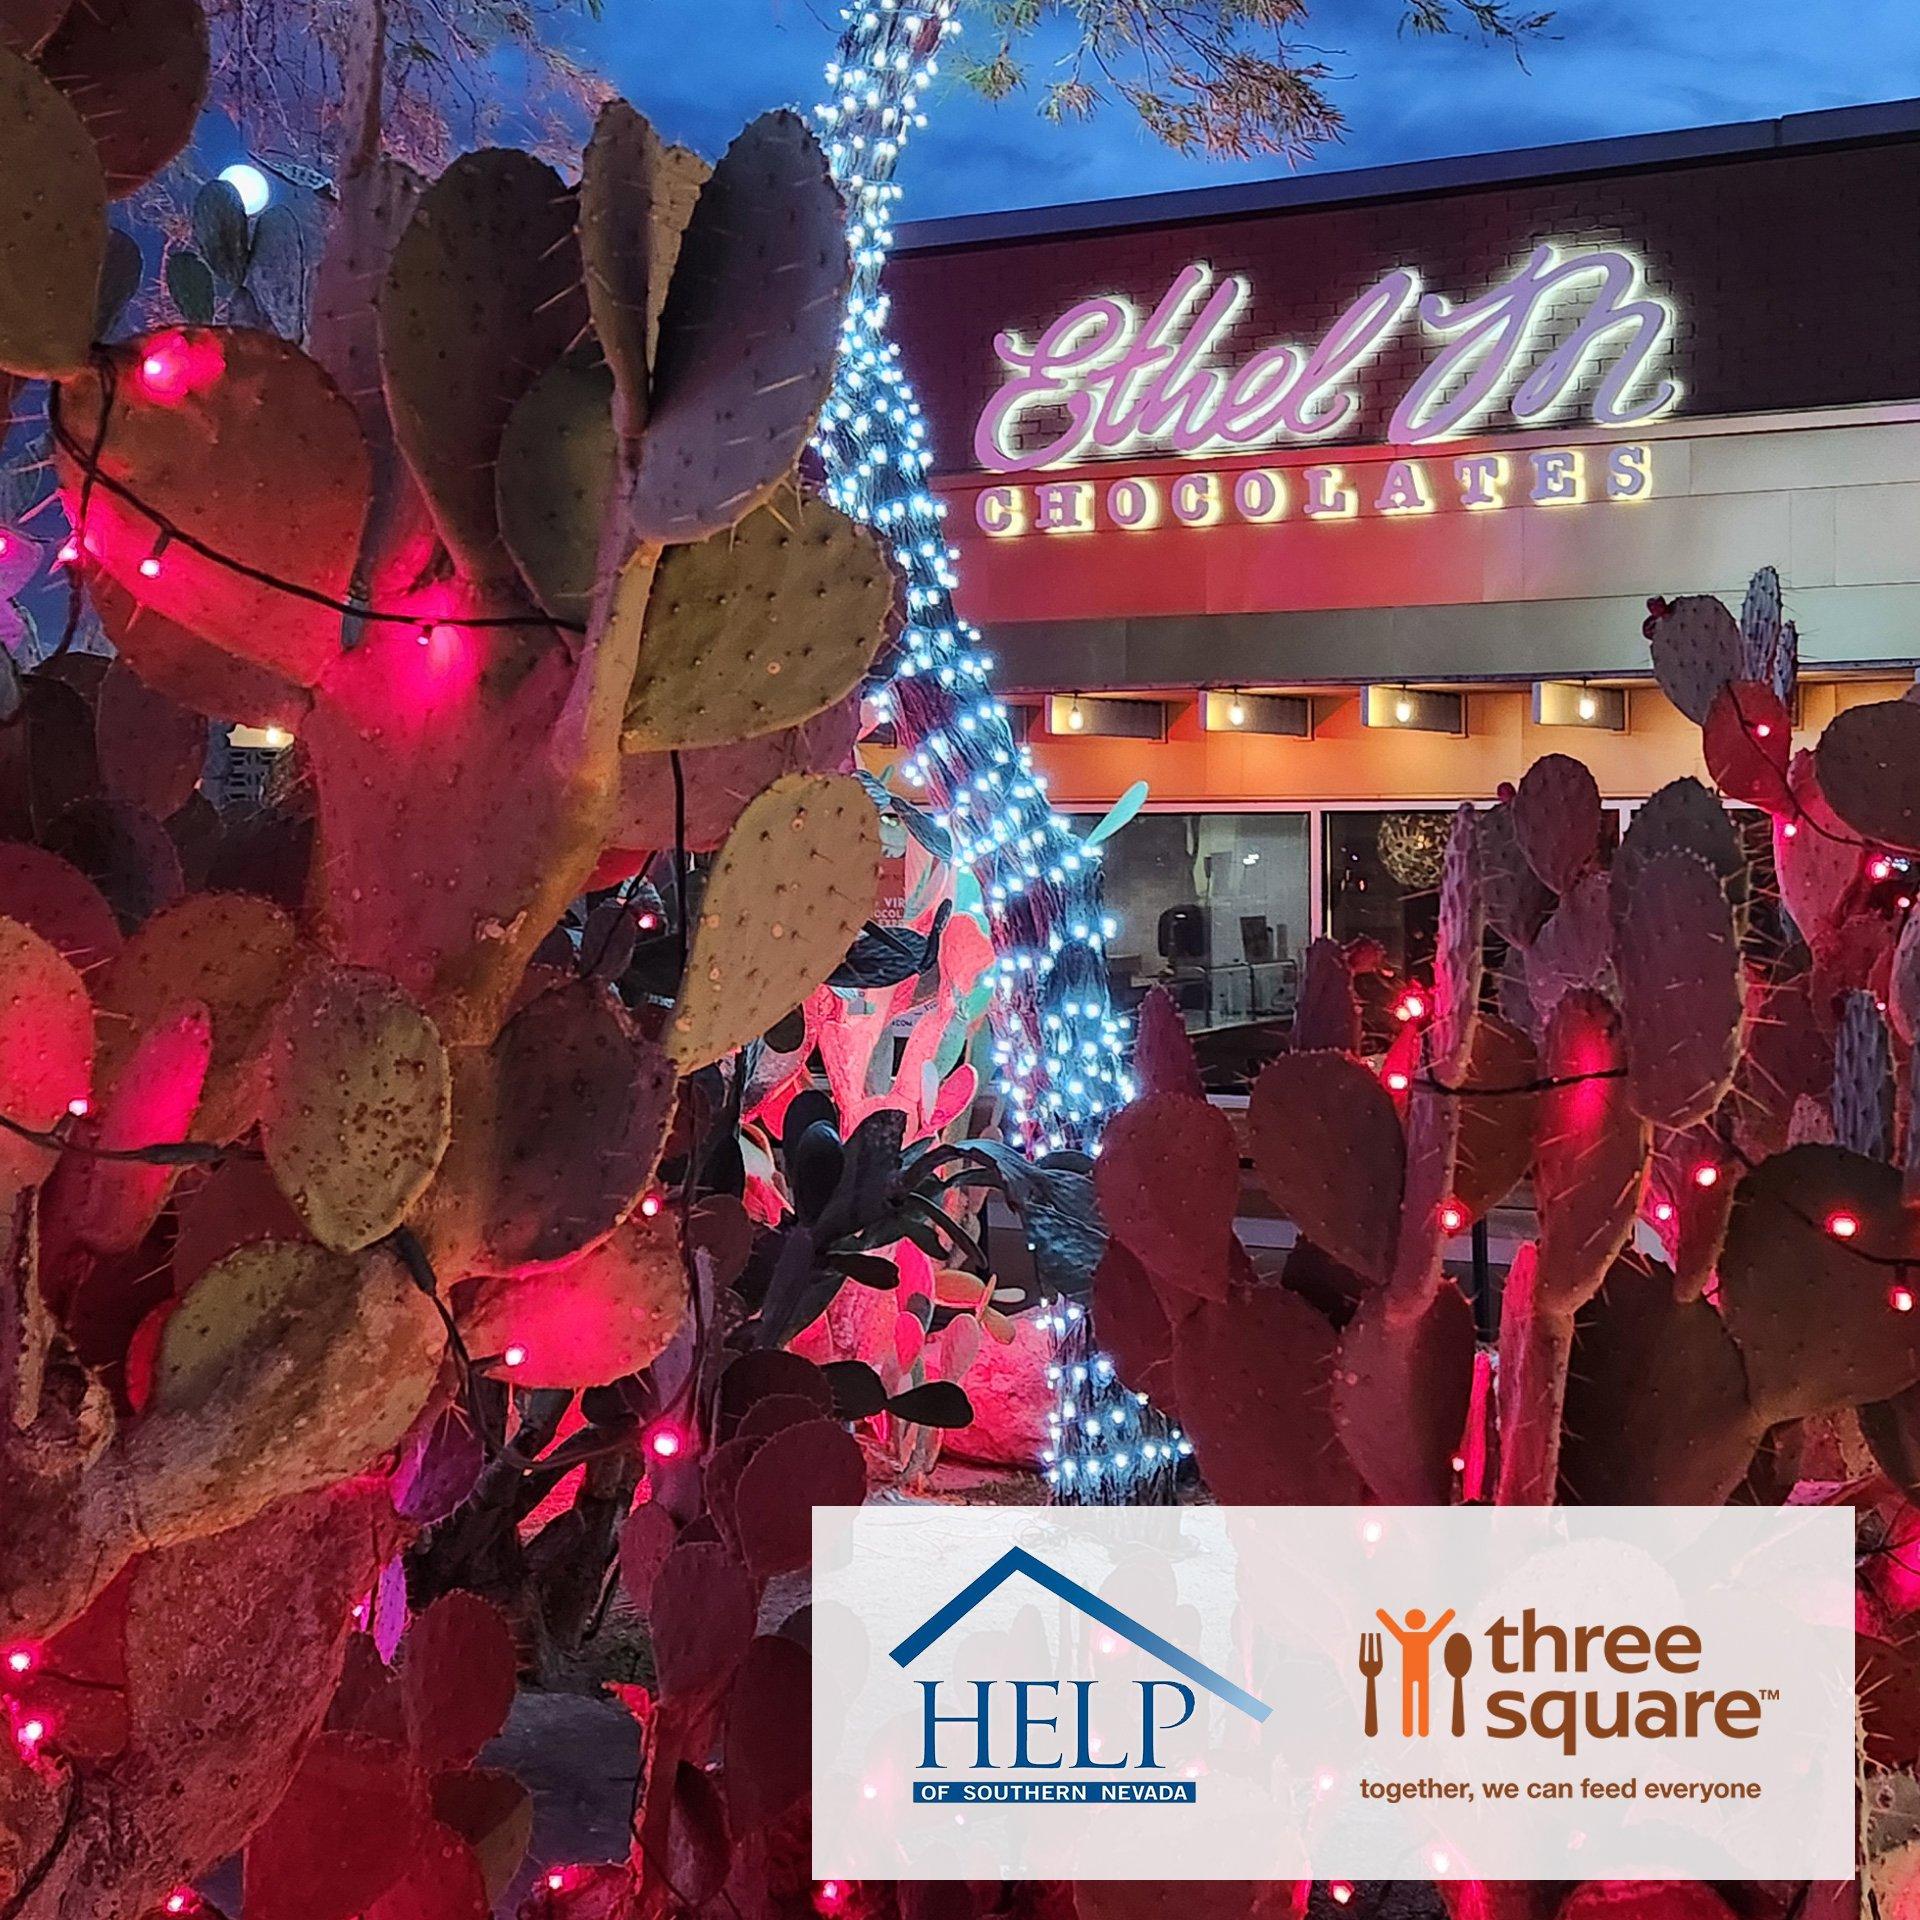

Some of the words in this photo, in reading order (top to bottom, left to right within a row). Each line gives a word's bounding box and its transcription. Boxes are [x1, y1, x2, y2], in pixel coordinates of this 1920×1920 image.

[974, 264, 1414, 472] Ethel
[1387, 243, 1677, 446] M
[975, 445, 1650, 534] CHOCOLATES
